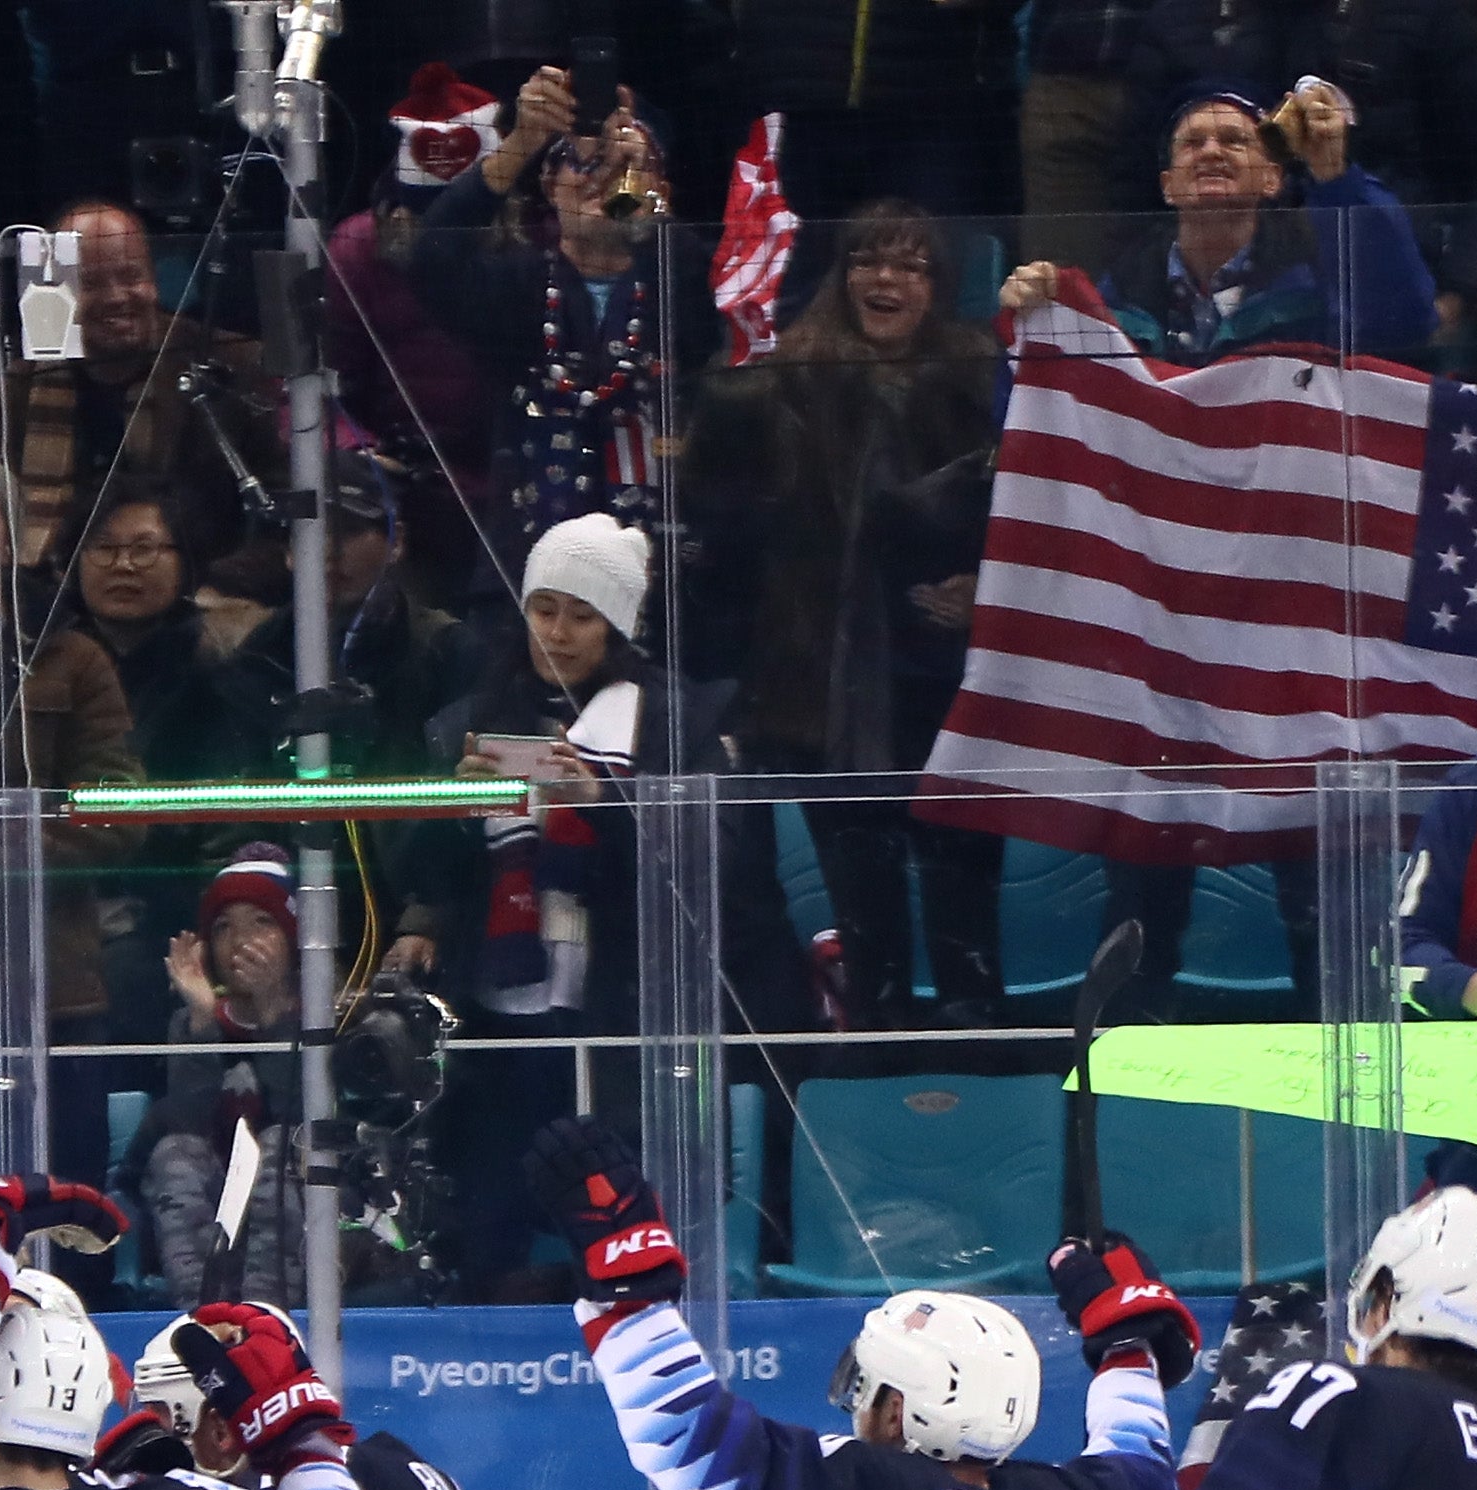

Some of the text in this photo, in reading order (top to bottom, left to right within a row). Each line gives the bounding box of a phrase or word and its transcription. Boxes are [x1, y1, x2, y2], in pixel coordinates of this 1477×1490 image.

[390, 1352, 604, 1397] PyeongCh
[1244, 1361, 1358, 1431] 97
[47, 1385, 77, 1412] 13
